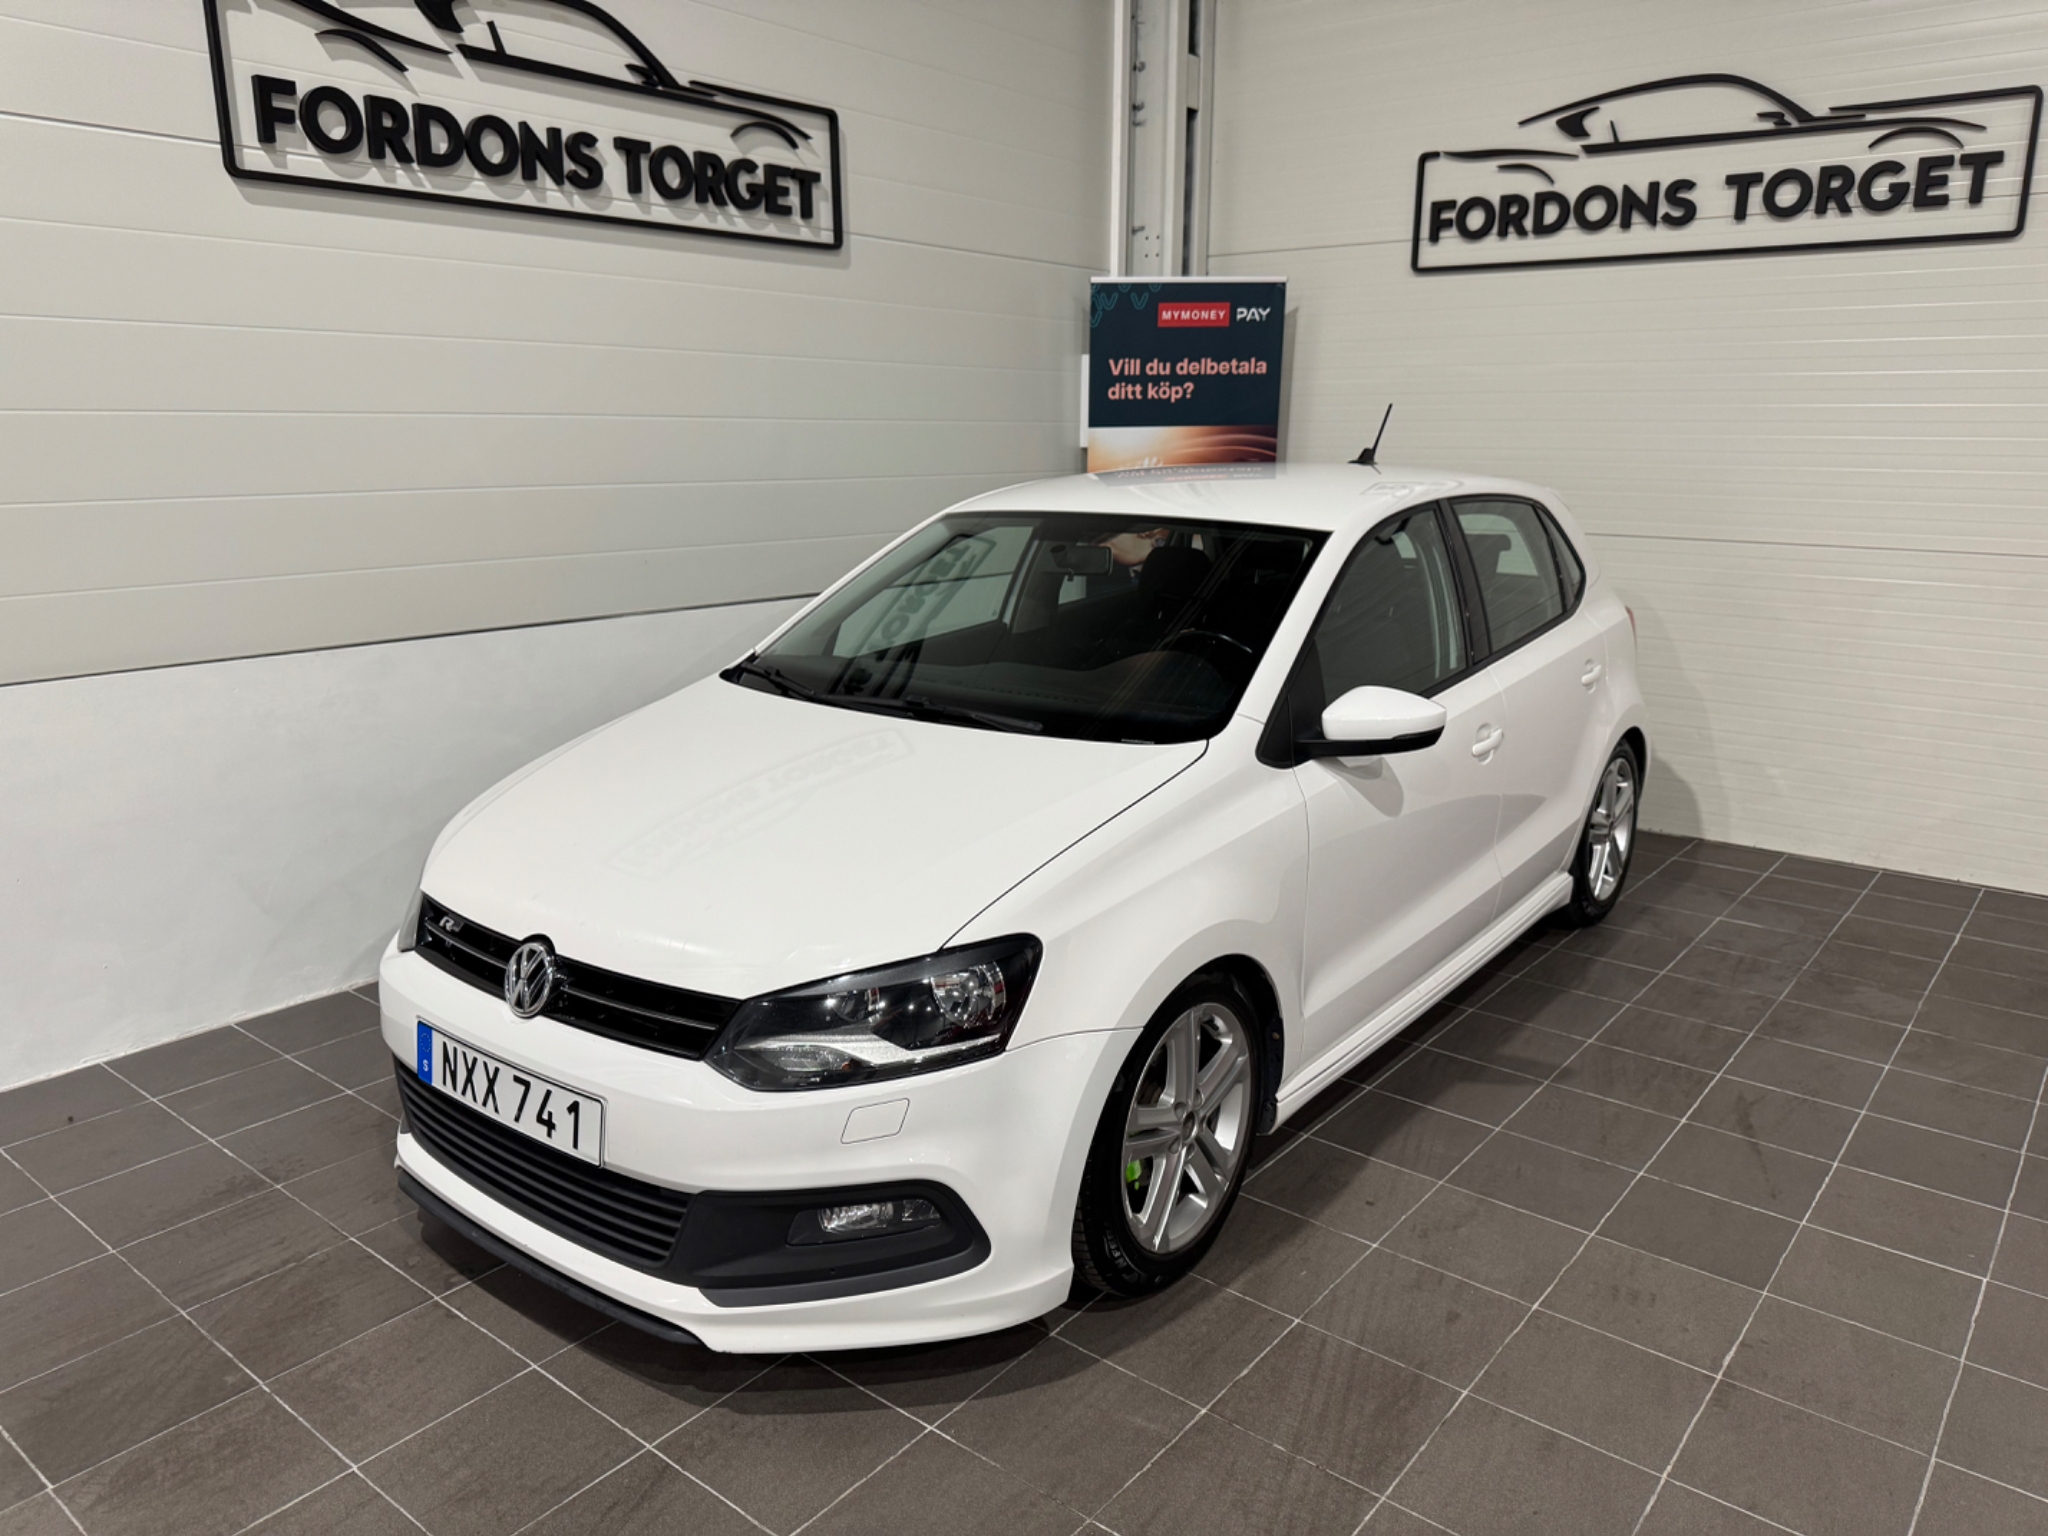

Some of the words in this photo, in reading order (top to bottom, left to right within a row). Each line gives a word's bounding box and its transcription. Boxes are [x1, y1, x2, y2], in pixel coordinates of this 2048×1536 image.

[251, 74, 604, 191] FORDONS
[613, 136, 821, 221] TORGET
[1428, 178, 1697, 244] FORDONS
[1725, 150, 2005, 222] TORGET
[1161, 309, 1227, 321] MYMONEY
[1236, 307, 1271, 322] PAY
[1107, 381, 1143, 400] ditt
[1147, 381, 1195, 403] köp?
[1108, 357, 1141, 376] Vill
[1145, 357, 1171, 376] du
[1175, 356, 1267, 375] delbetala
[442, 1041, 500, 1114] NXX
[512, 1074, 580, 1150] 741
